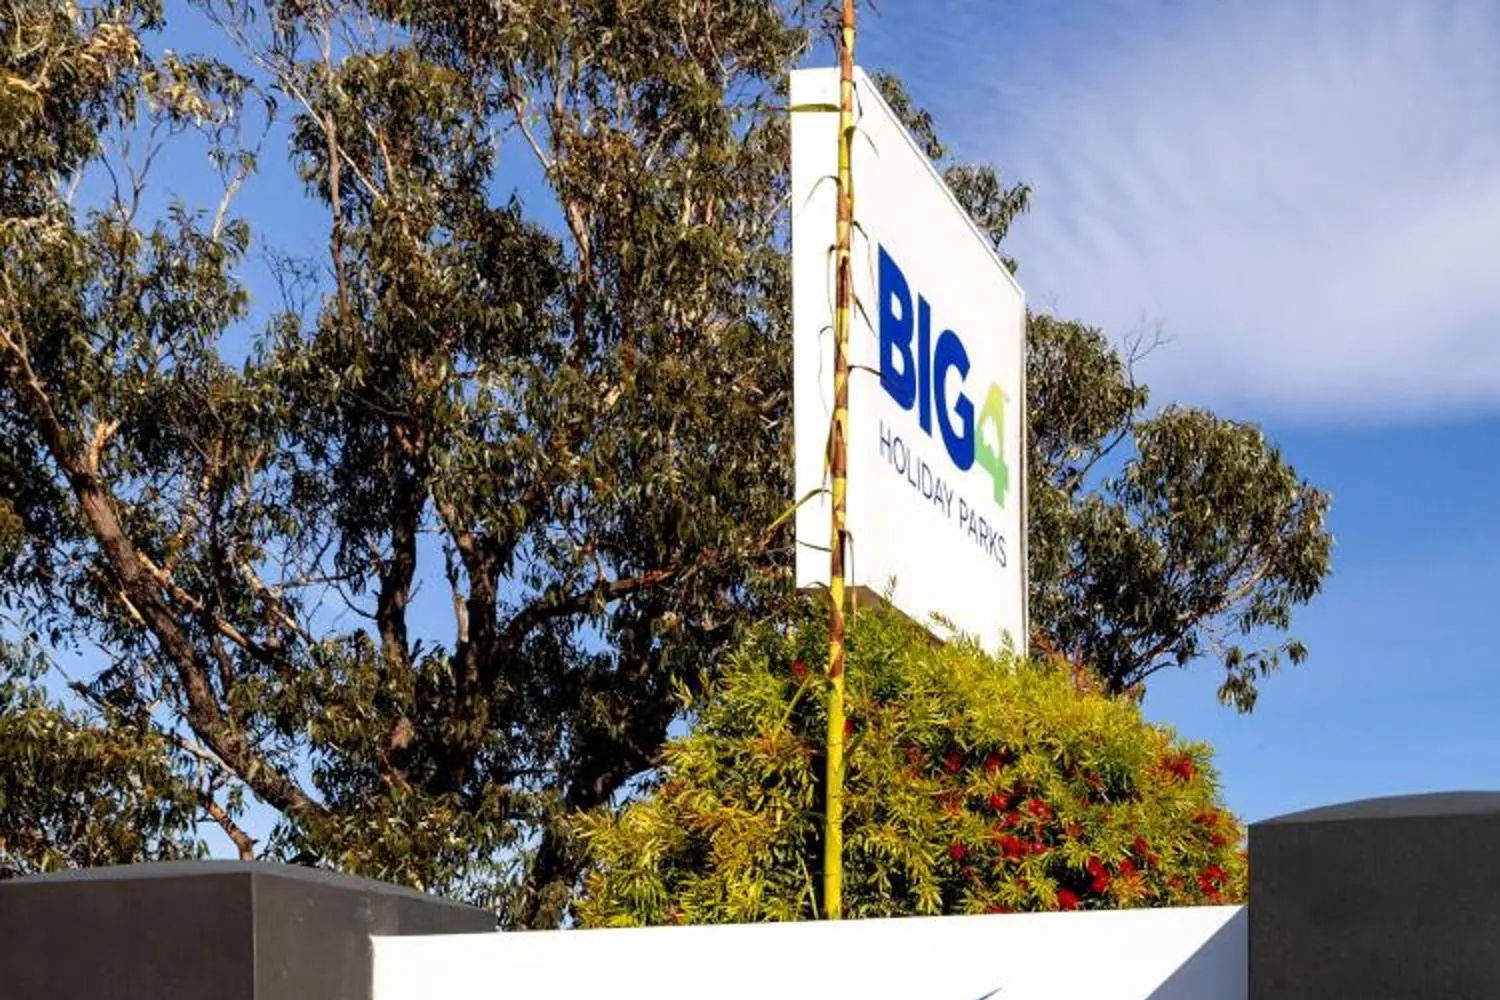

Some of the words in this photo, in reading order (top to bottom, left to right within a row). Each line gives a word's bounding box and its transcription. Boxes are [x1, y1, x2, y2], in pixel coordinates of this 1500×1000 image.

[878, 242, 1009, 510] BIG4
[879, 419, 954, 519] HOLIDAY
[959, 496, 1007, 568] PARKS
